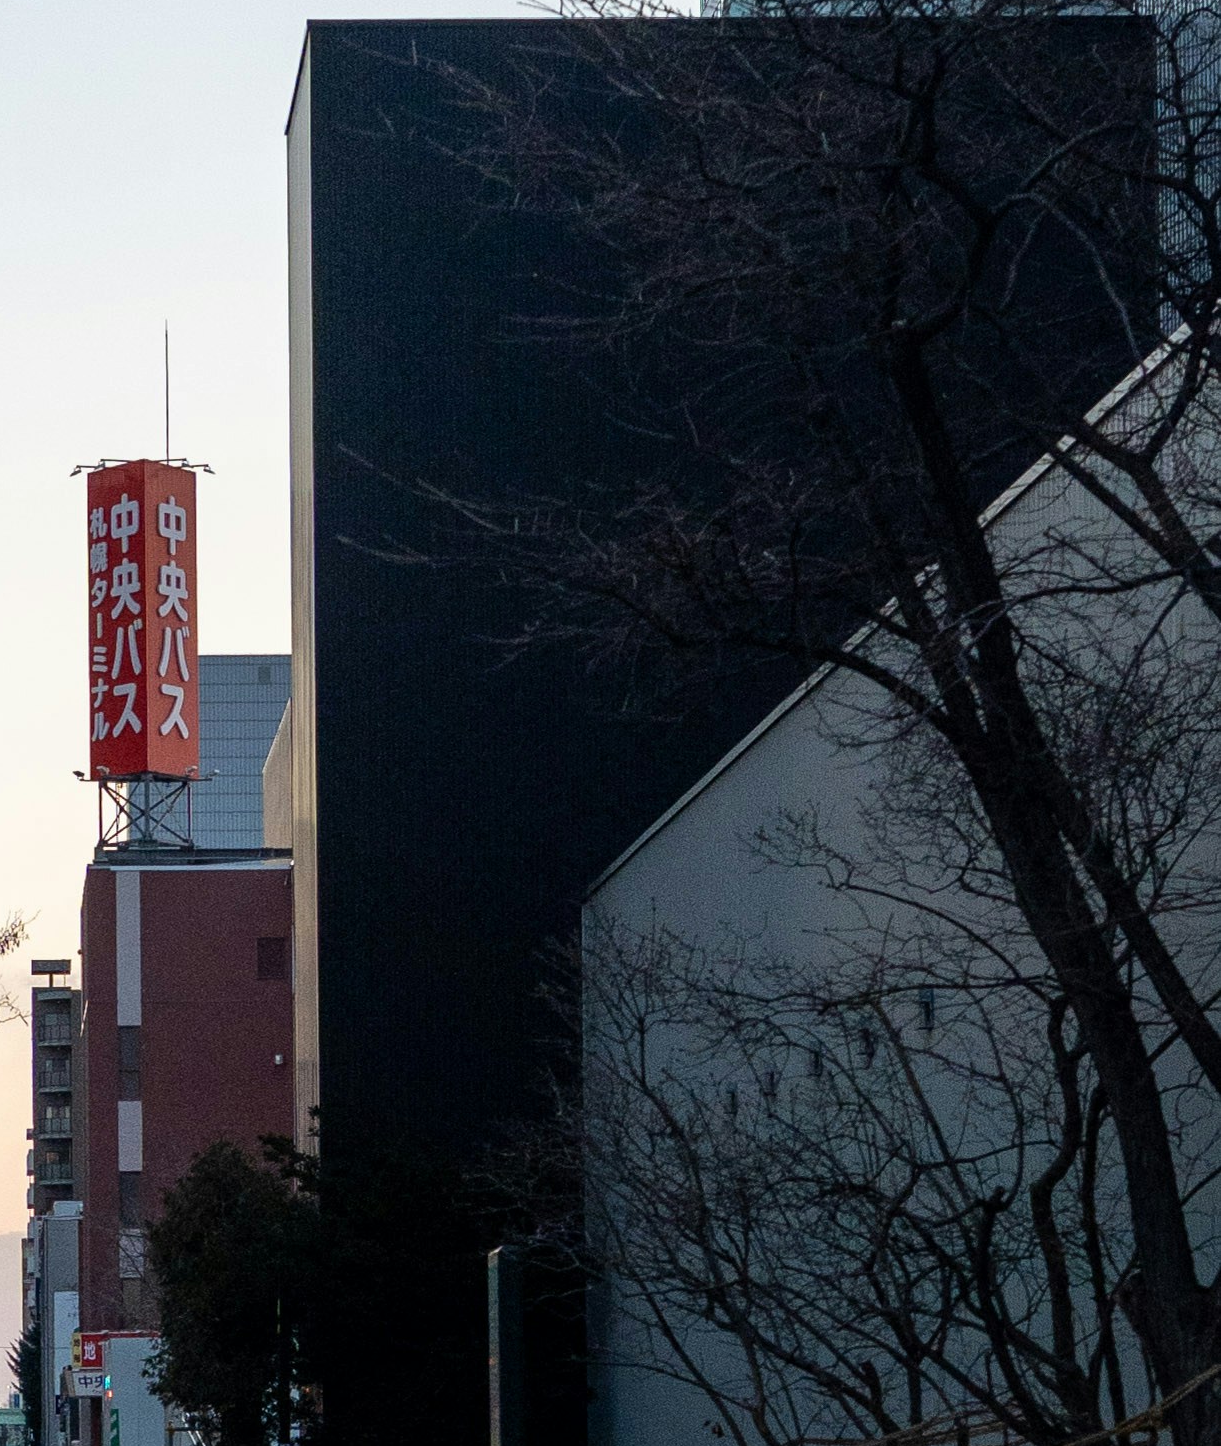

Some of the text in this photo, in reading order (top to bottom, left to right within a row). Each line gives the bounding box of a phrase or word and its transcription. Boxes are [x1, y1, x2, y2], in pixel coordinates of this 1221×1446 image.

[90, 507, 109, 741] 札幌ターミナル
[110, 493, 143, 739] 中央バス
[157, 495, 190, 740] 中央バス
